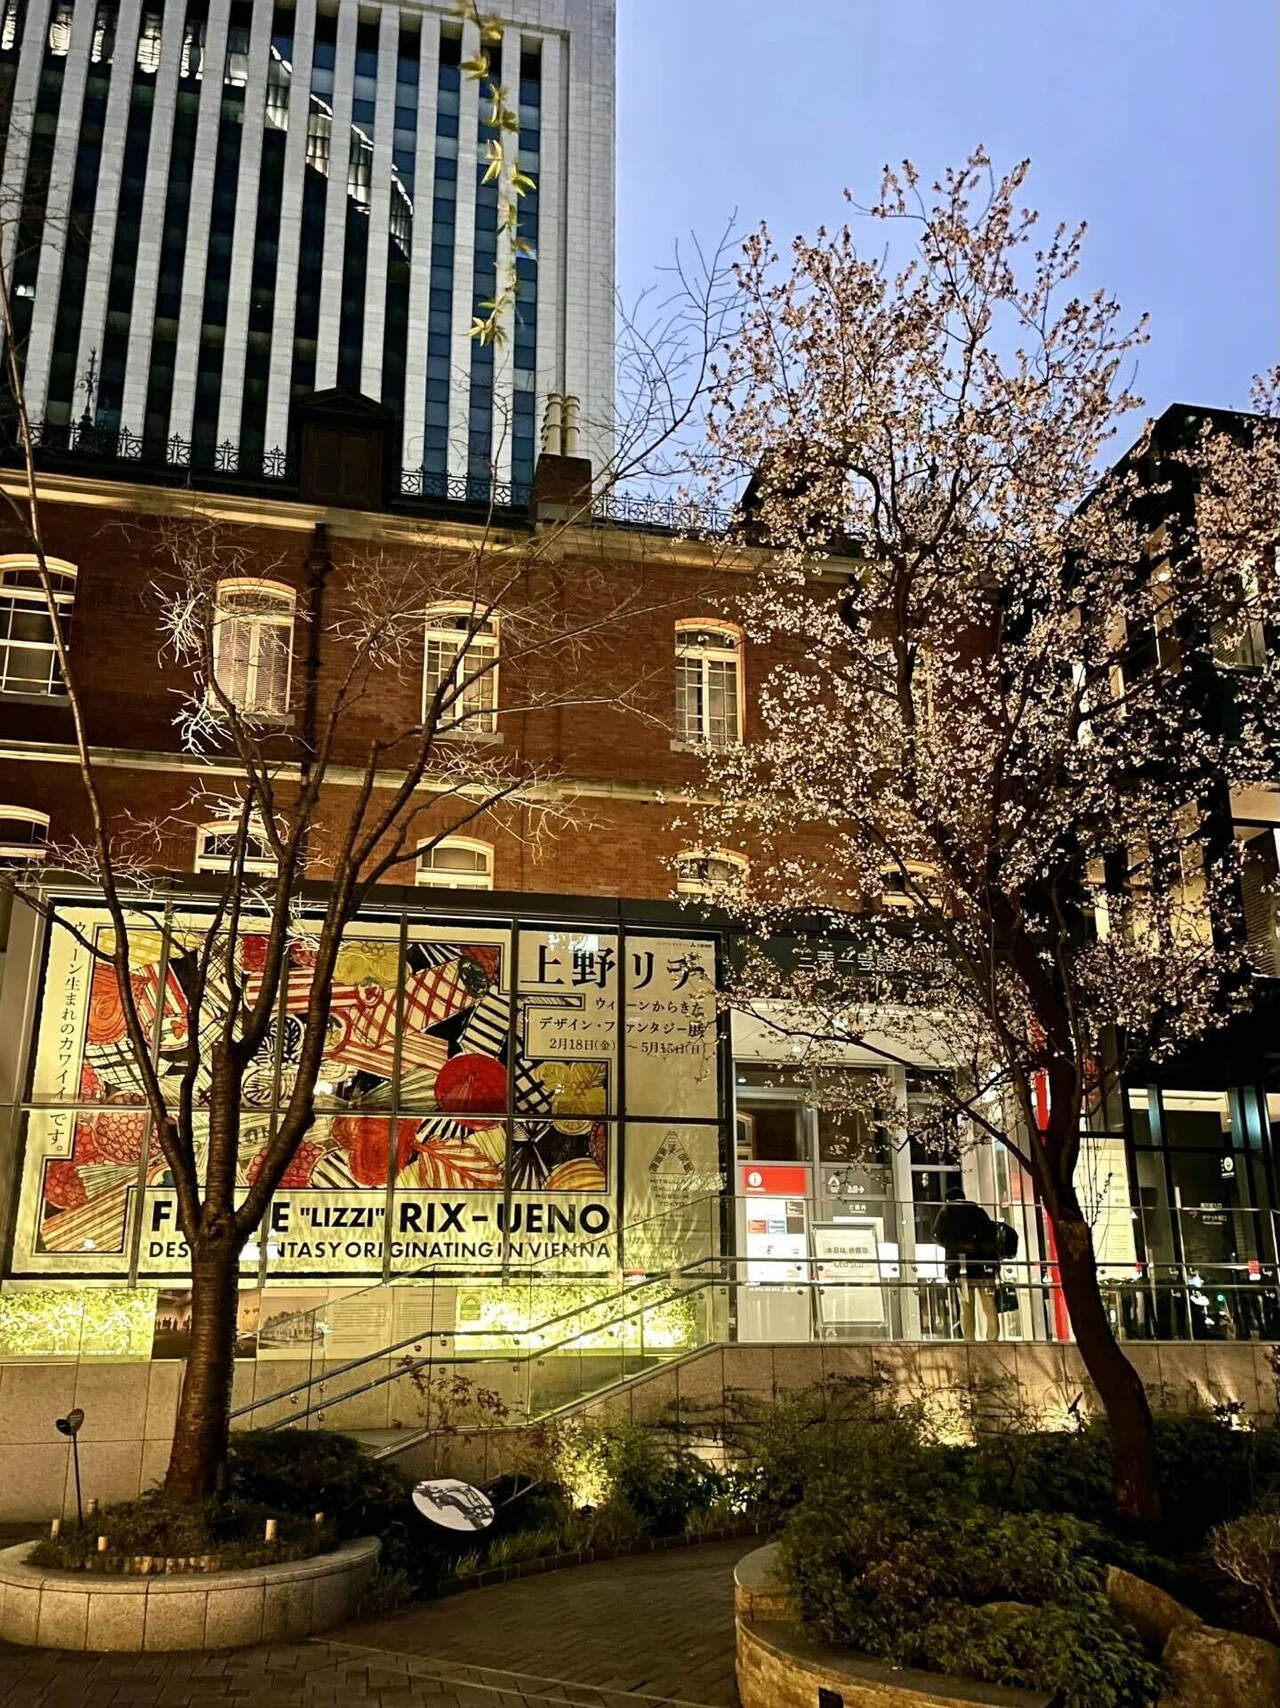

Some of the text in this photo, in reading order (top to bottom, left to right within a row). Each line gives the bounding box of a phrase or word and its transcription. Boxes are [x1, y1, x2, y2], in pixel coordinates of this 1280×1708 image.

[520, 945, 705, 991] 上野リチ
[595, 997, 705, 1017] ウィーンからきた
[47, 921, 87, 1152] ウーン生まれのカワイイです。
[300, 1207, 385, 1228] "LIZZI"
[345, 1241, 493, 1259] ORIGINATING
[498, 1242, 524, 1259] IN
[528, 1242, 611, 1259] VIENNA
